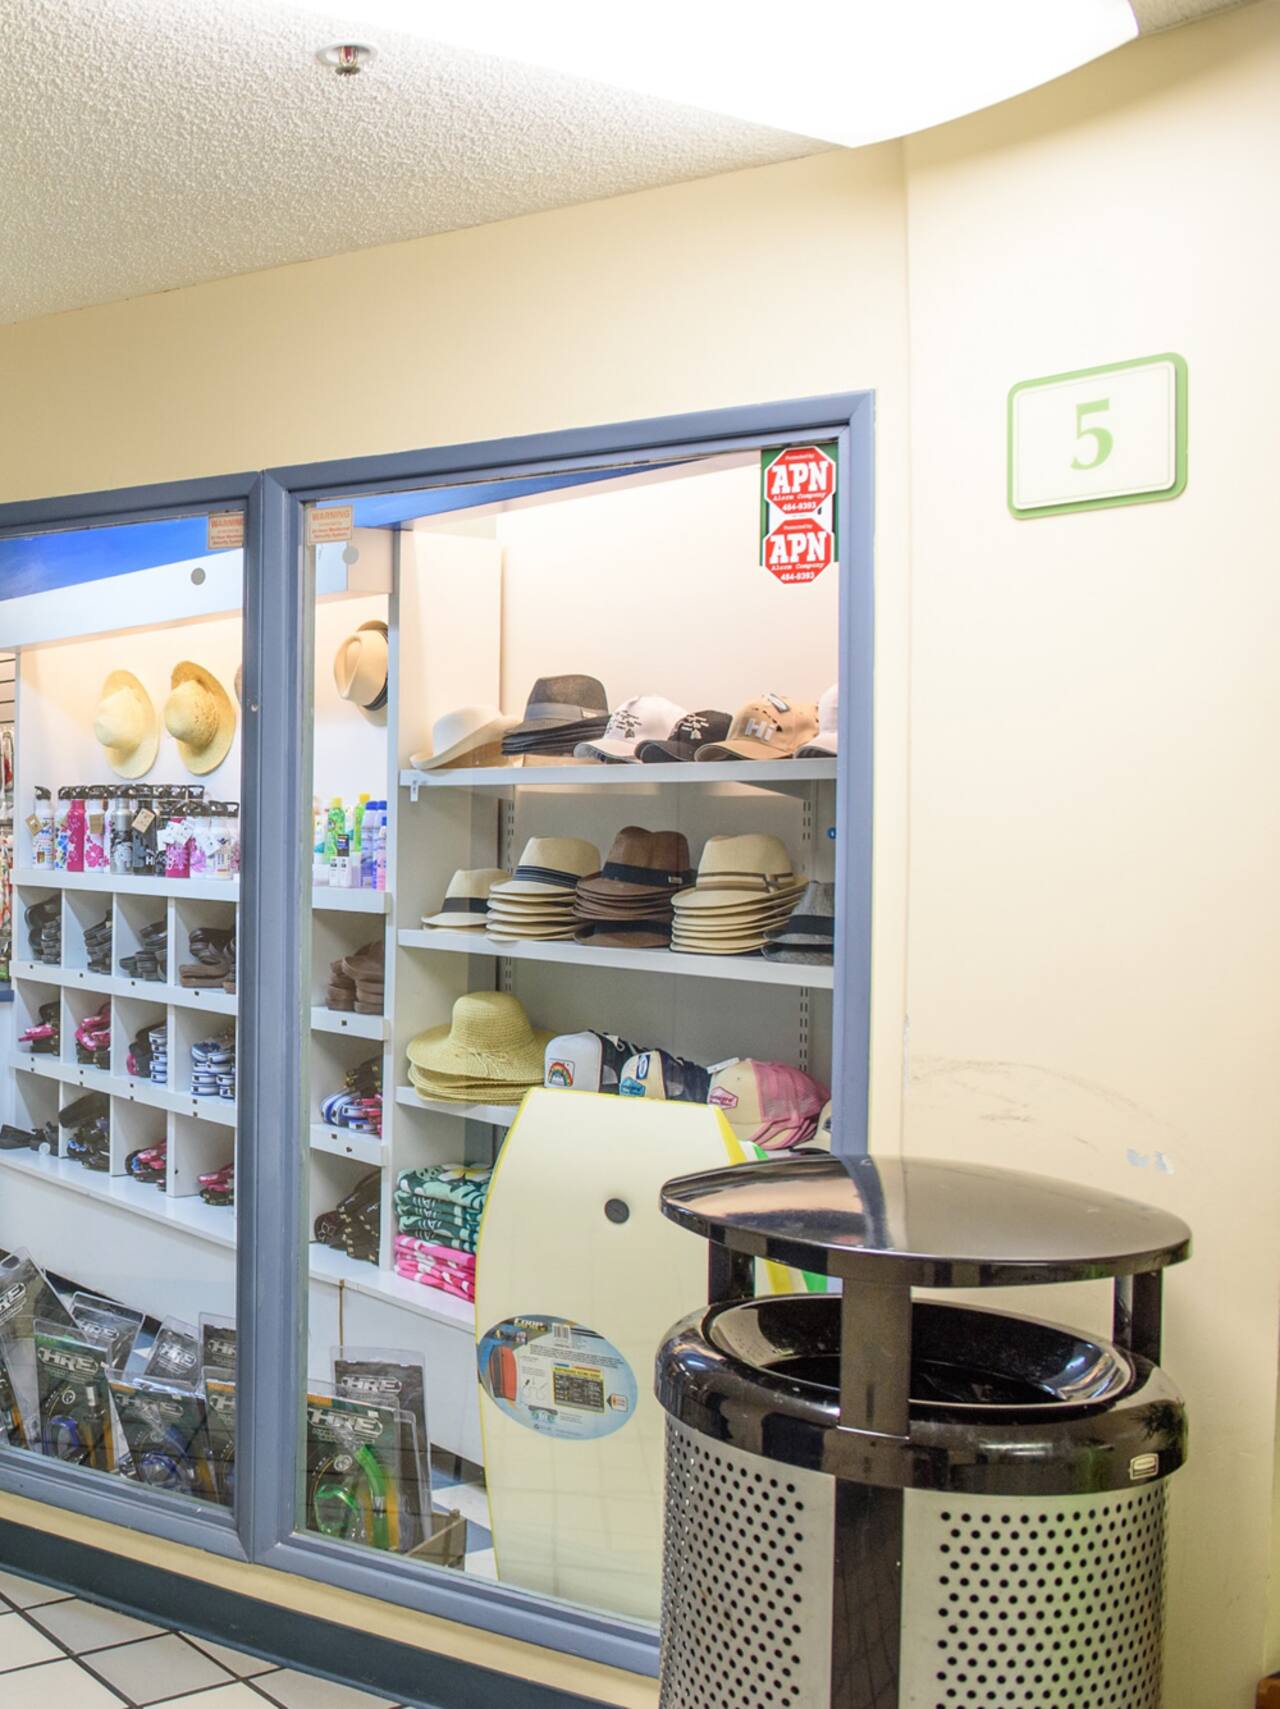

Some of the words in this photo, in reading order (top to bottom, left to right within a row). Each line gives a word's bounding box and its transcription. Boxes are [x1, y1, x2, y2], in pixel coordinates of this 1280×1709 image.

[1070, 398, 1114, 470] 5
[771, 461, 829, 494] APN
[211, 518, 244, 528] WARNIN
[769, 530, 827, 564] APN
